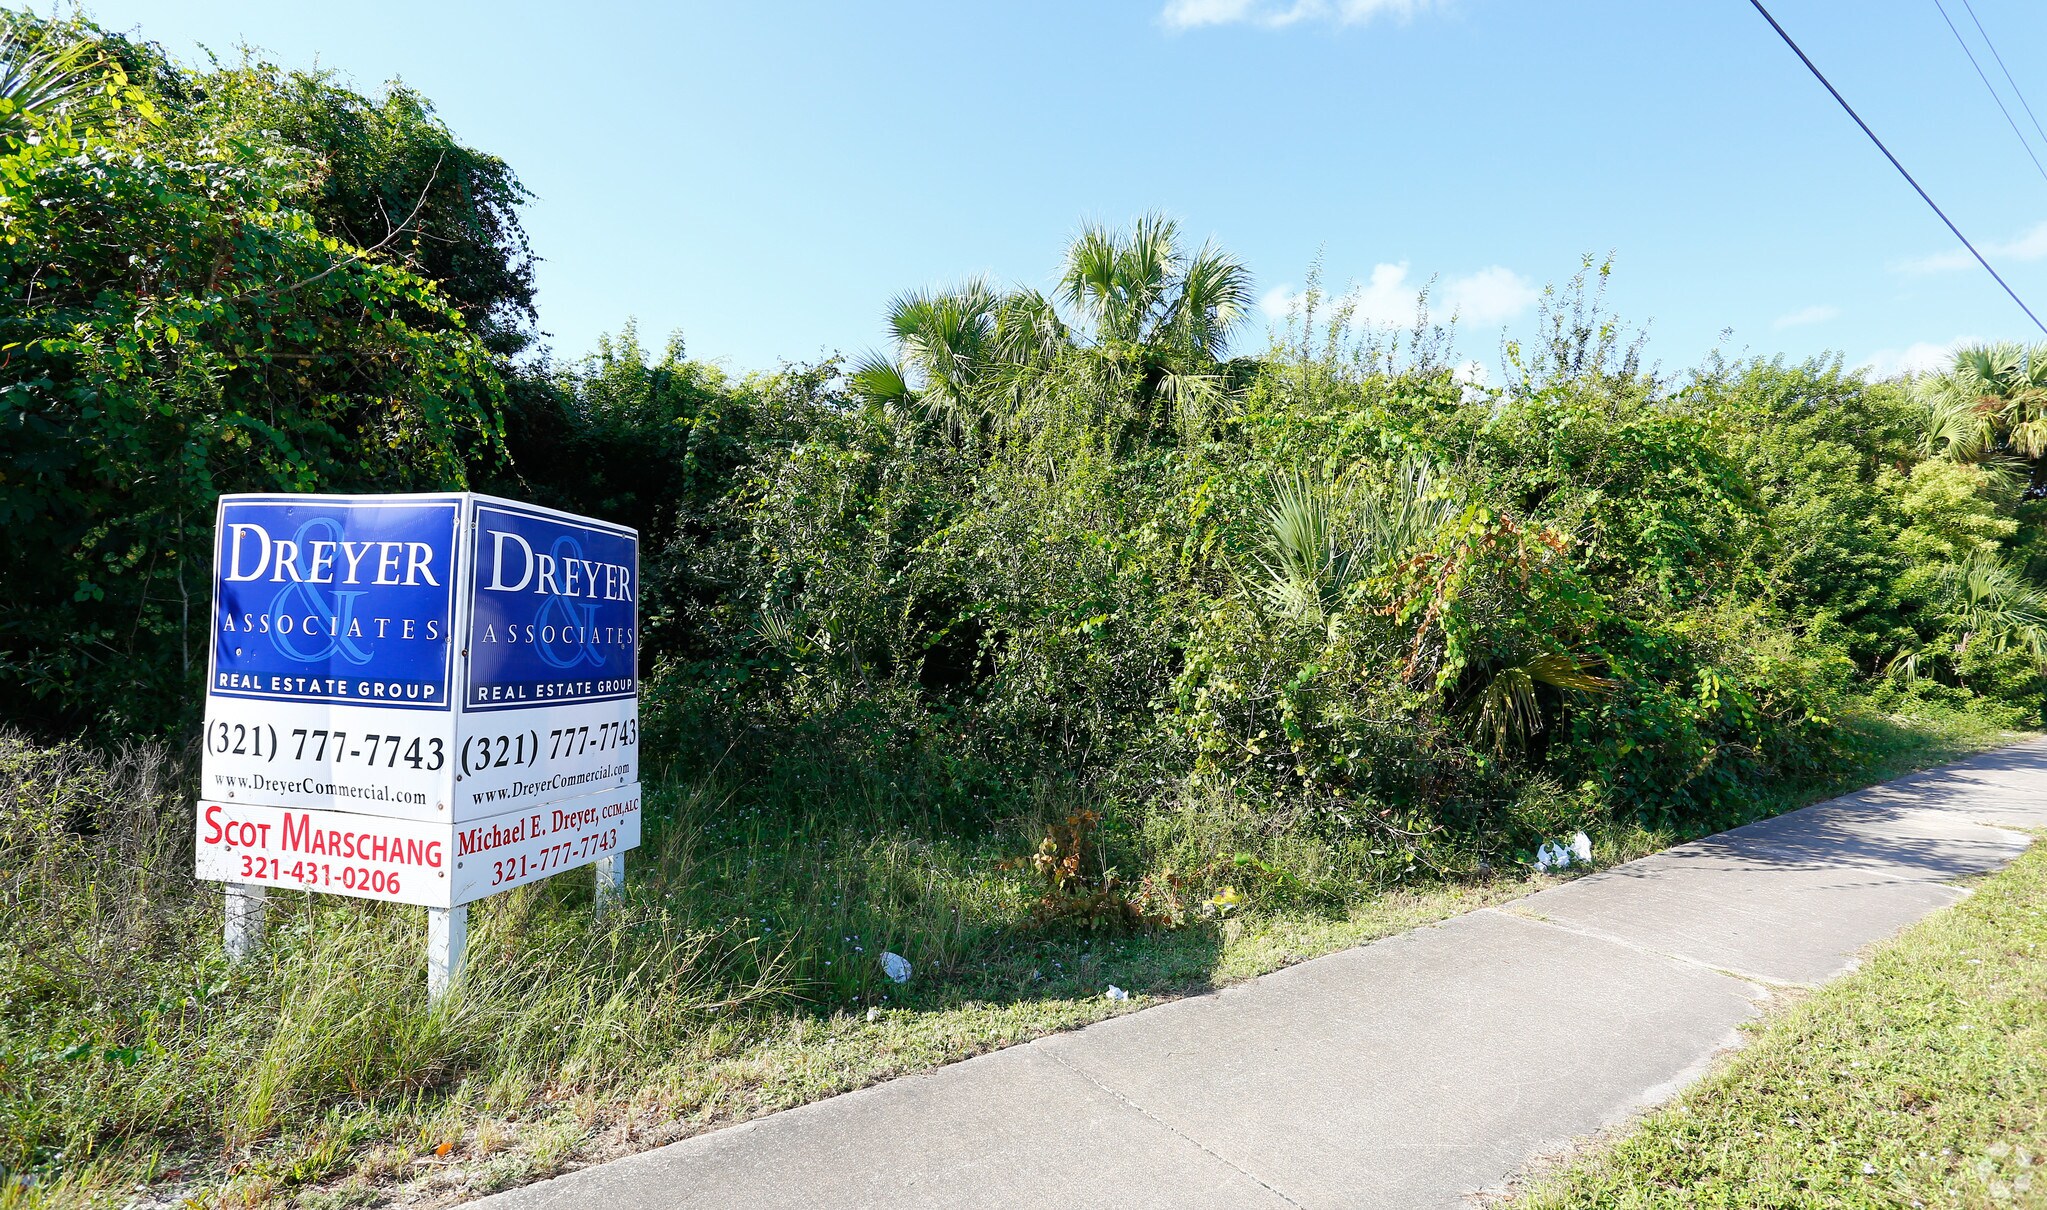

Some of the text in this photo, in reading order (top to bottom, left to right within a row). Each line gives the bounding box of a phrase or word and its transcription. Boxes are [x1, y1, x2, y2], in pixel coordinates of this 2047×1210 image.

[225, 523, 440, 586] DREYER
[483, 530, 633, 602] DREYER
[268, 517, 375, 665] &
[534, 535, 606, 669] &
[223, 613, 439, 641] ASSOCIATES
[482, 624, 633, 644] ASSOCIATES
[219, 673, 435, 699] REAL ESTATE GROUP
[479, 679, 632, 700] REAL ESTATE GROUP
[207, 719, 445, 771] (321) 777-7743
[461, 718, 636, 777] (321) 777-7743
[215, 774, 427, 805] www.DreyerCommercial.com
[473, 762, 630, 805] www.DreyerCommercial.com
[204, 806, 442, 868] SCOT MARSCHANG
[458, 798, 639, 857] Michael E. Dreyer, CCIM,ALC
[241, 855, 400, 894] 321-431-0206
[492, 828, 617, 886] 321-777-7743
